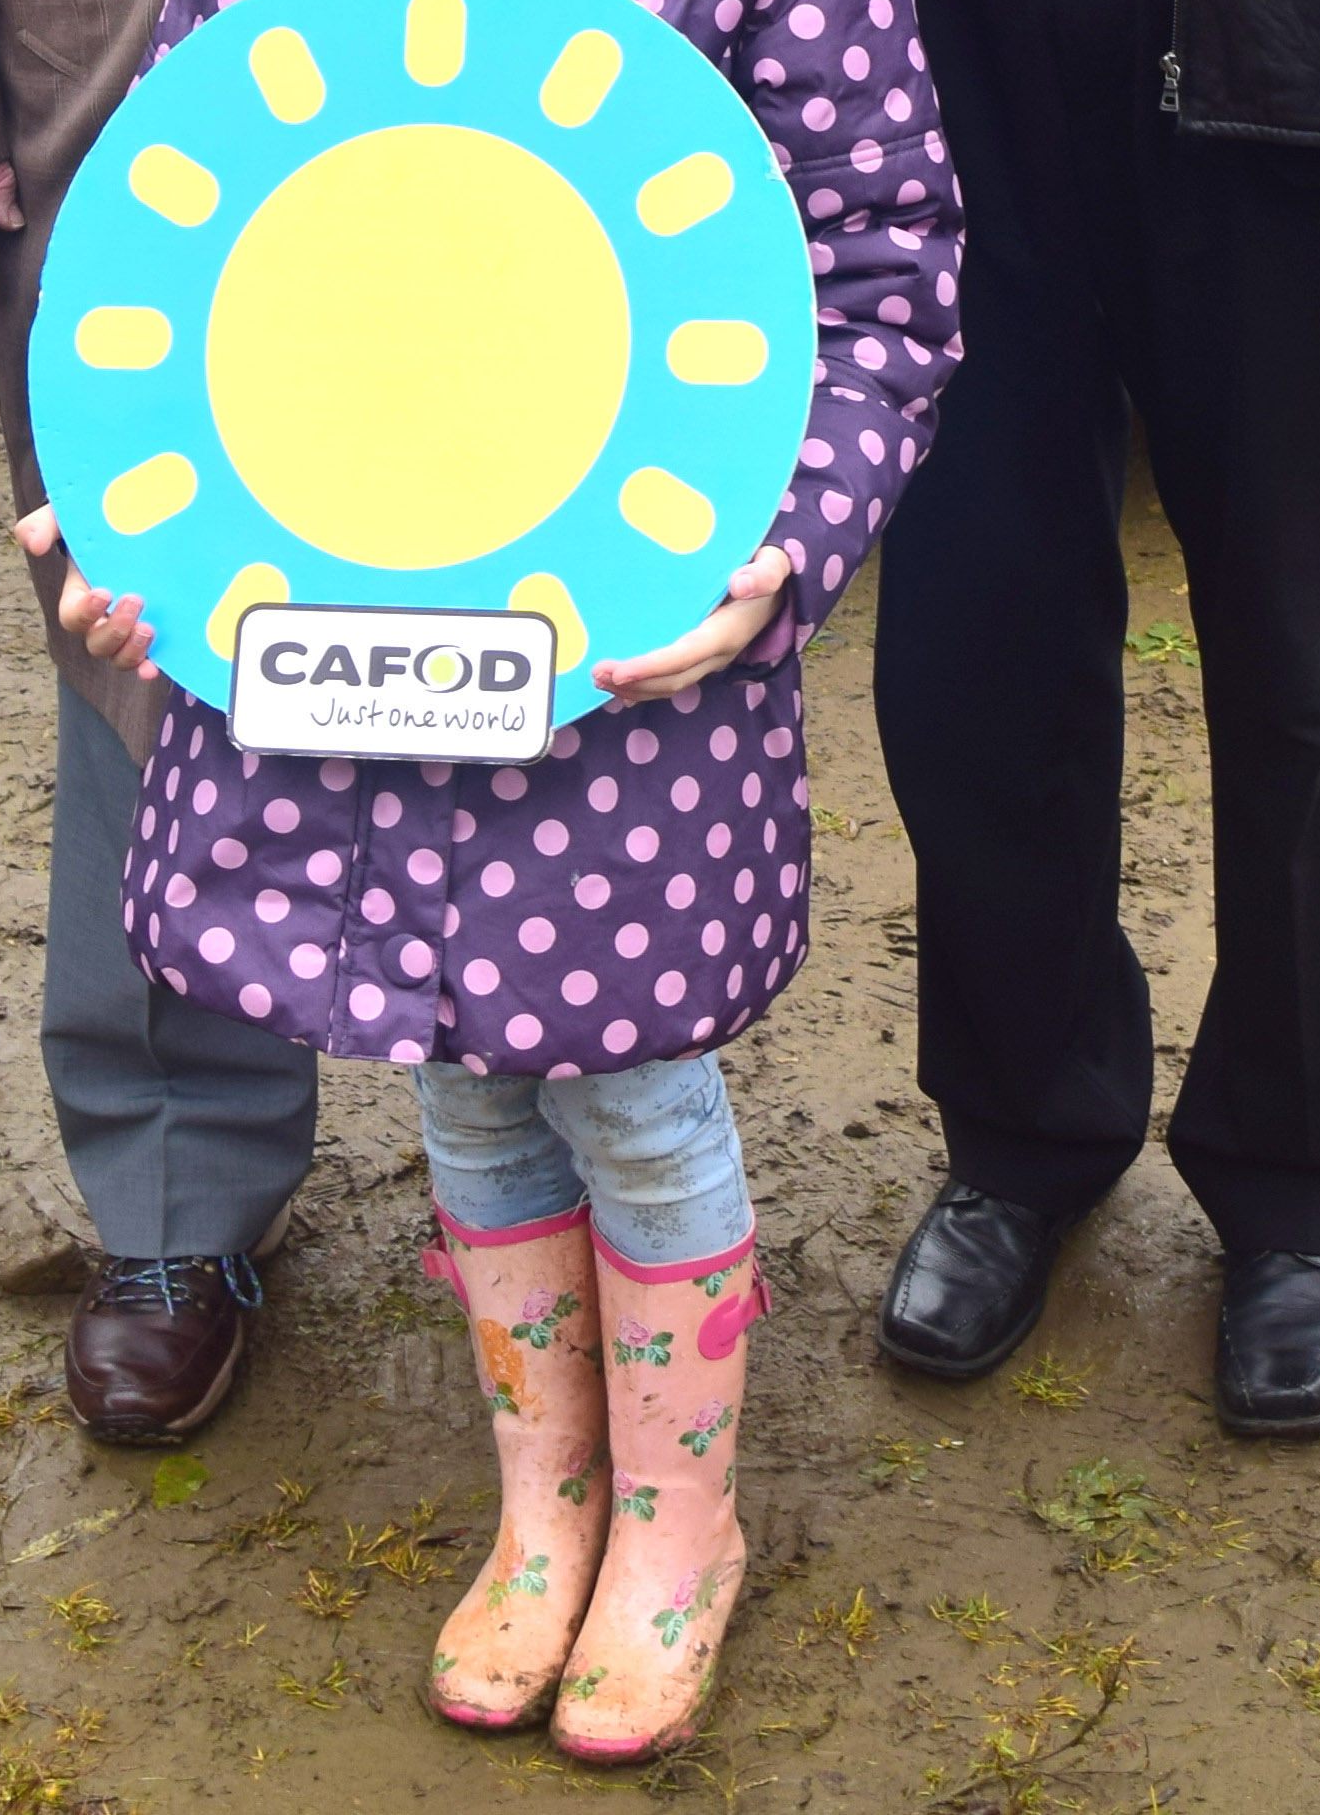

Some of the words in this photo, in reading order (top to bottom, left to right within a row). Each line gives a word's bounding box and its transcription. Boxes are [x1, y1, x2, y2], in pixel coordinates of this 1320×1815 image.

[260, 641, 531, 693] CAFOD
[310, 698, 383, 727] Just
[389, 708, 437, 729] one
[445, 704, 526, 732] world
